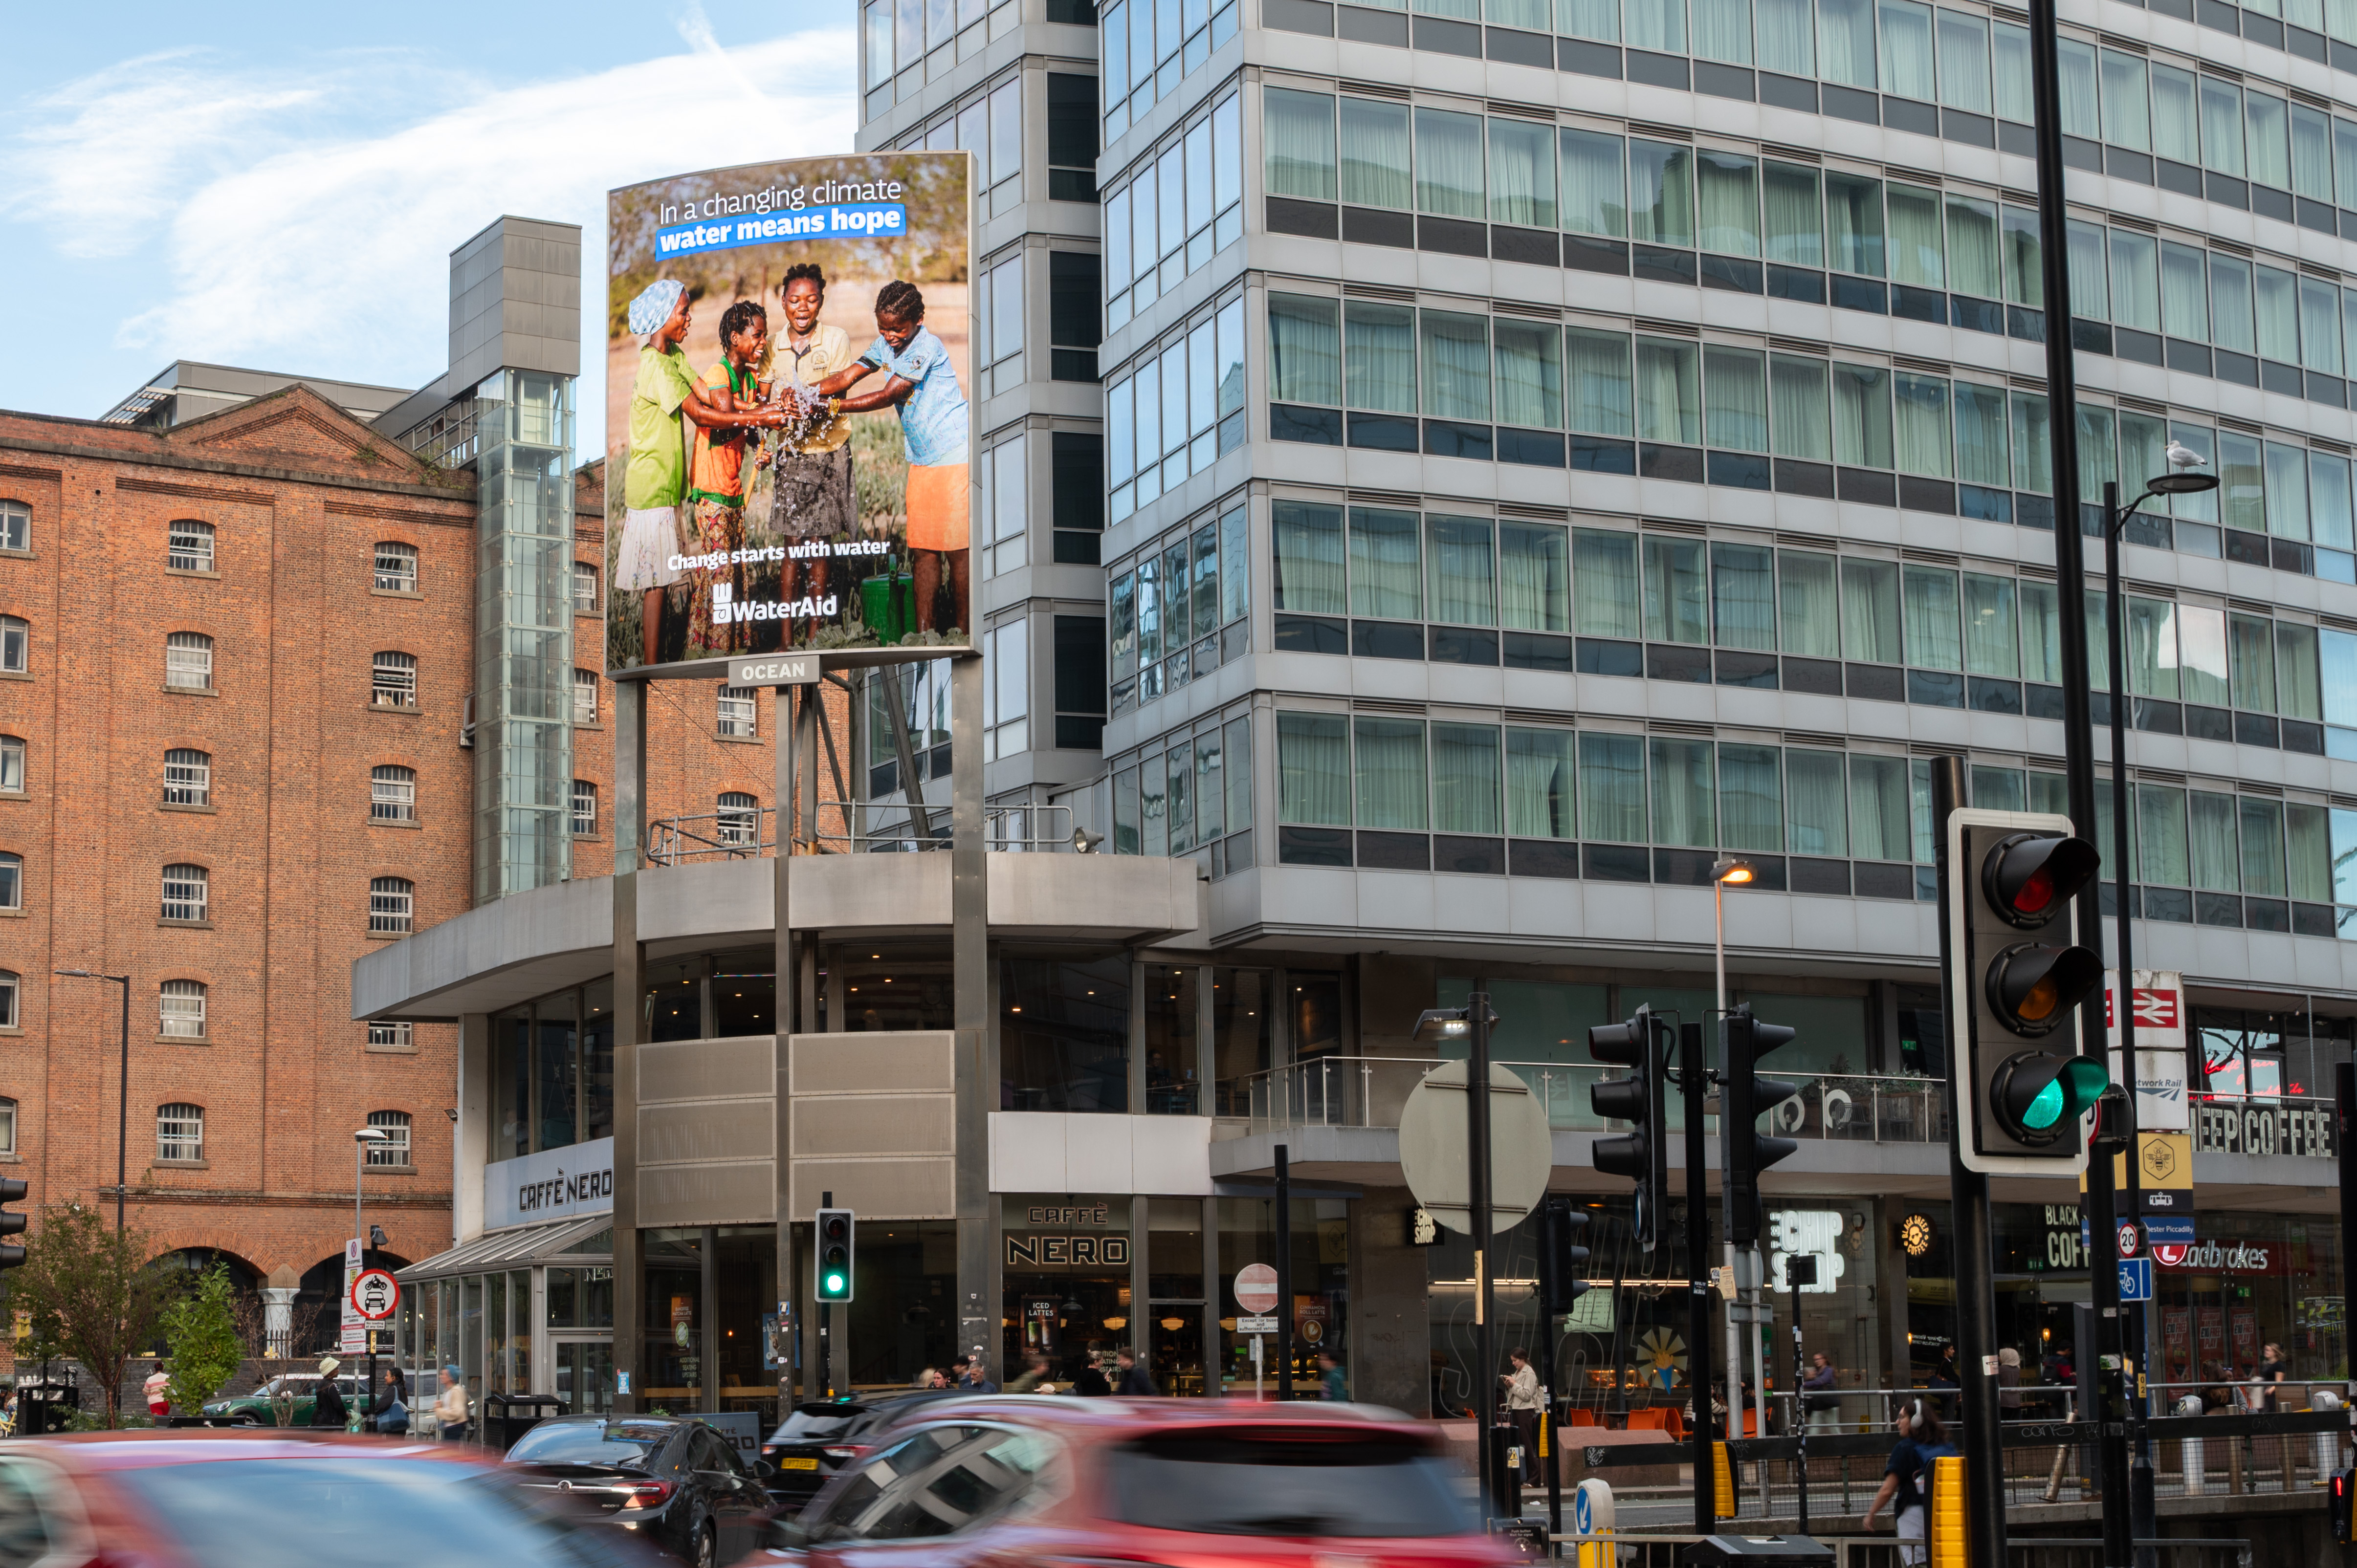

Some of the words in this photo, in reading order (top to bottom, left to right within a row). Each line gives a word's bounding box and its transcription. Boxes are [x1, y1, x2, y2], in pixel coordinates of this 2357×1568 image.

[661, 203, 677, 225] In
[684, 202, 698, 220] a
[704, 185, 805, 217] changing
[813, 179, 901, 204] climate
[660, 224, 732, 252] water
[737, 215, 825, 240] means
[831, 208, 901, 234] hope
[667, 551, 728, 570] Change
[731, 545, 785, 564] starts
[788, 540, 830, 559] with
[833, 540, 890, 556] water
[732, 595, 837, 622] WaterAid
[742, 663, 805, 681] OCEAN
[2245, 1110, 2332, 1157] COFFEE
[520, 1167, 564, 1213] CAFFÈ
[567, 1168, 612, 1204] NERO
[1028, 1201, 1108, 1224] CAFFÈ
[2045, 1205, 2080, 1226] BLACK
[1415, 1225, 1435, 1244] SHOP
[1781, 1210, 1843, 1251] CHIP
[1901, 1216, 1914, 1239] BLACK
[1914, 1215, 1929, 1232] SHEEP
[2166, 1225, 2193, 1235] Piccadilly
[1007, 1235, 1128, 1266] NERO
[1907, 1240, 1928, 1256] COFFEE
[2121, 1233, 2135, 1247] 20
[1772, 1251, 1845, 1293] SOP
[2166, 1324, 2176, 1333] £10
[2176, 1323, 2186, 1333] FREE
[2170, 1333, 2182, 1344] PLAY
[2201, 1327, 2210, 1338] £10
[2210, 1327, 2221, 1337] FREE
[2234, 1324, 2243, 1334] £10
[2244, 1323, 2253, 1334] FREE
[2204, 1338, 2217, 1349] PLAY
[2238, 1334, 2250, 1344] PLAY
